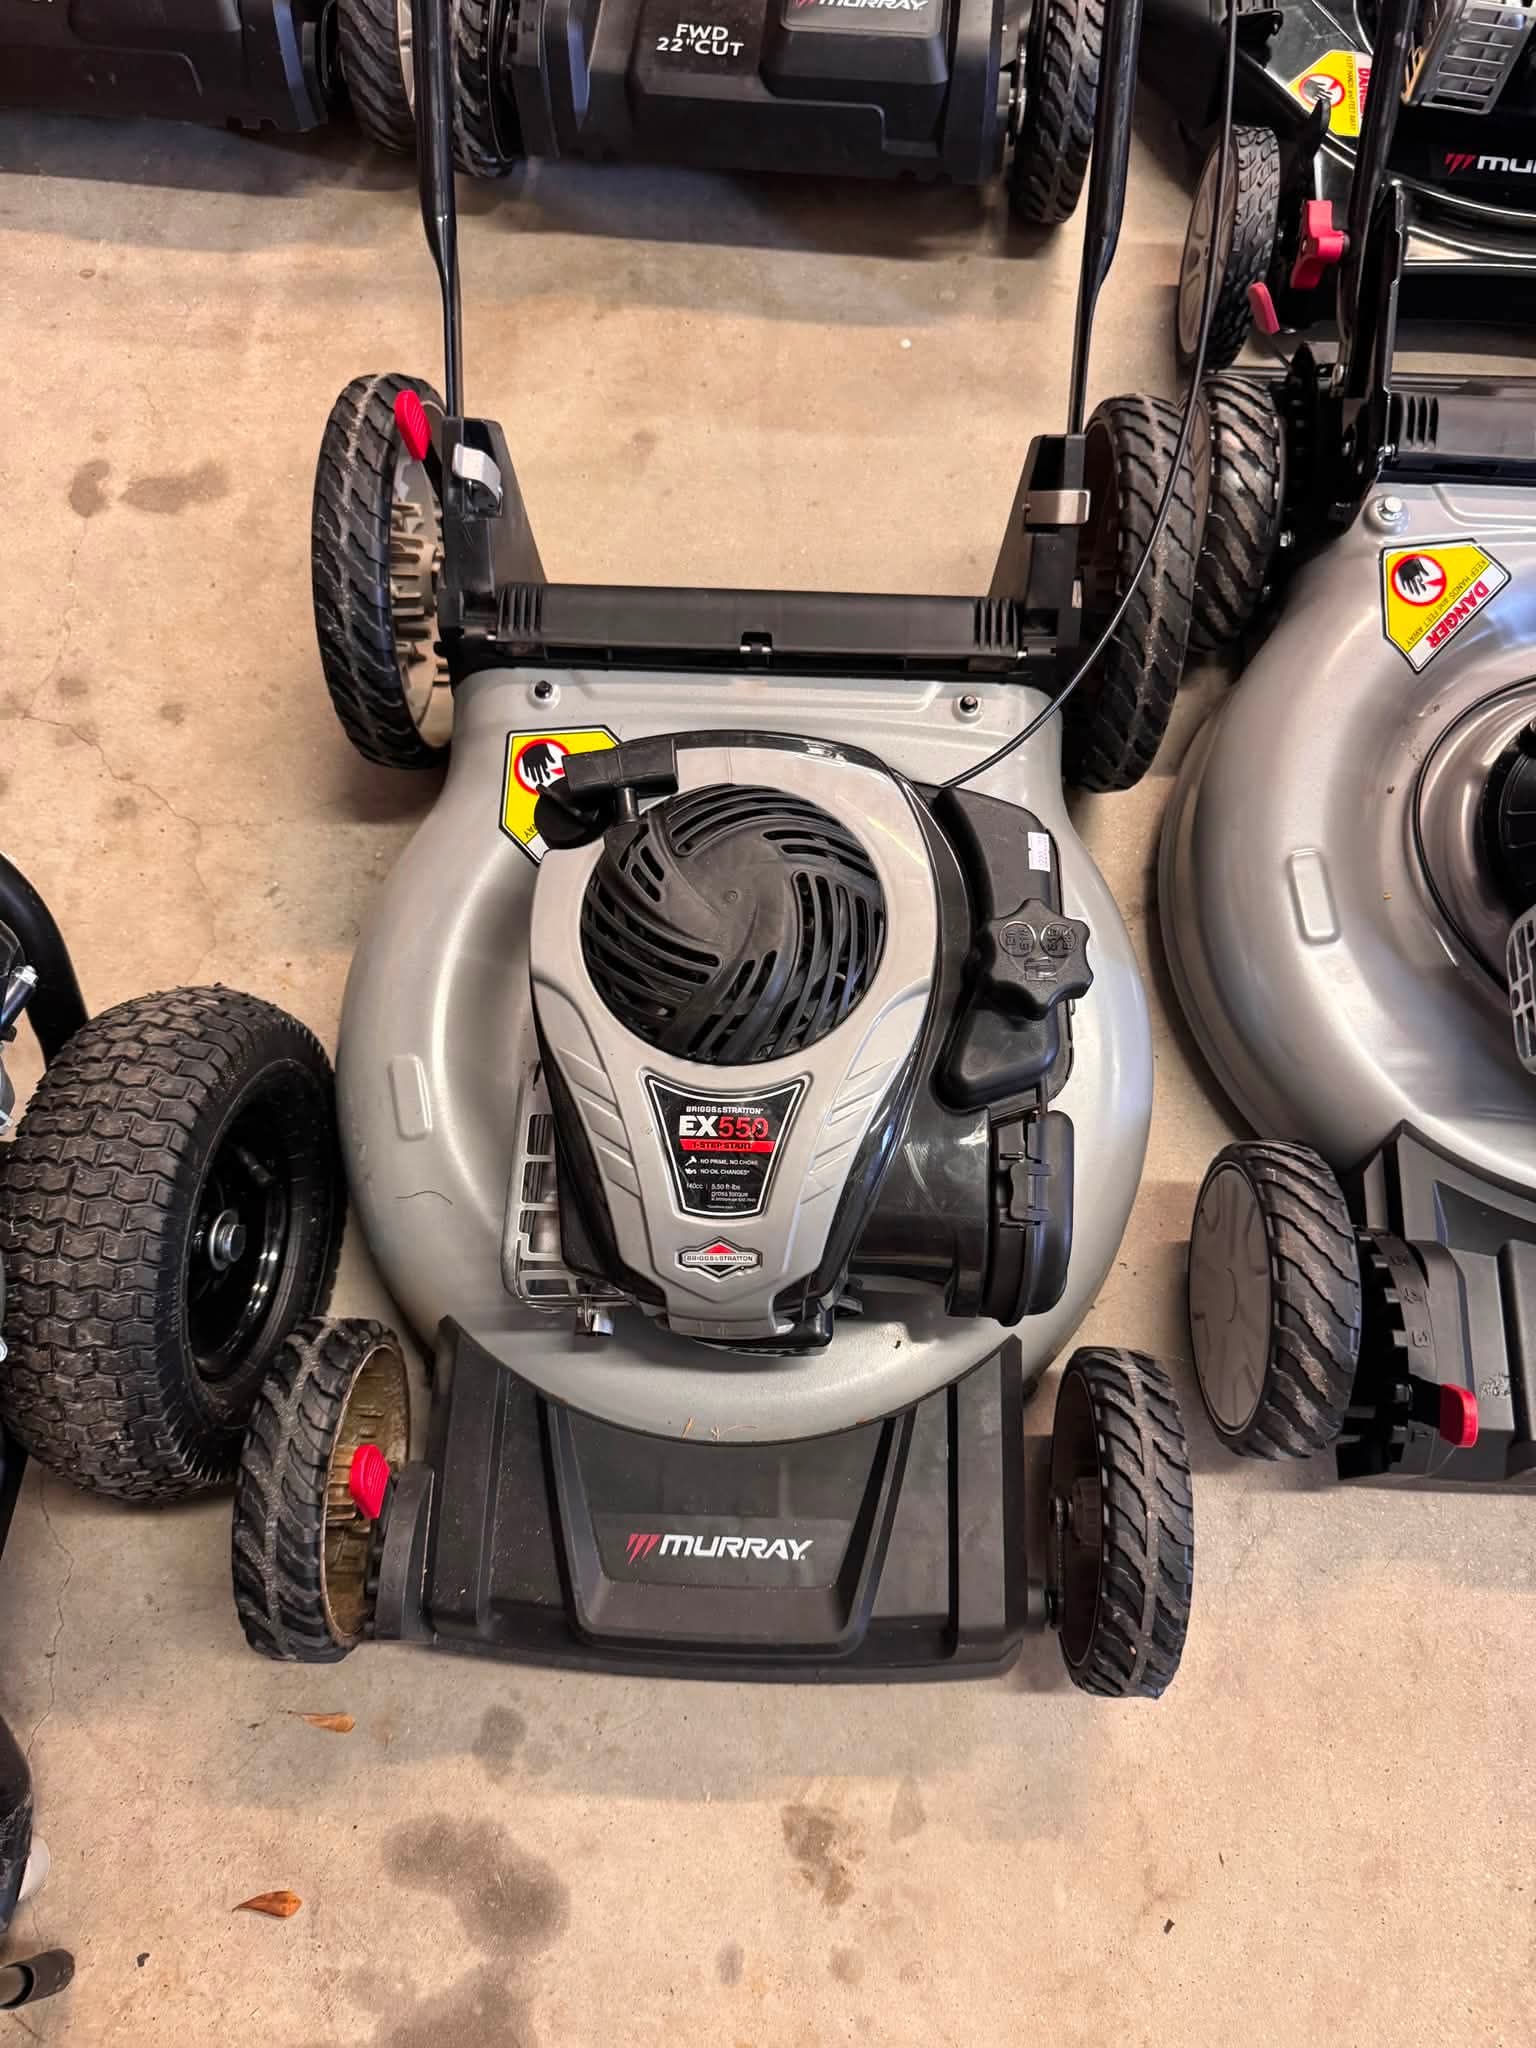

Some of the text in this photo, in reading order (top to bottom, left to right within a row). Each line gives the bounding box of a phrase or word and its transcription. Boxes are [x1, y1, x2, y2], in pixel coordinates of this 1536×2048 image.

[676, 23, 729, 40] FWD
[656, 36, 744, 56] 22"CUT
[1477, 155, 1536, 174] MU
[1470, 559, 1487, 578] KEEP
[1449, 575, 1472, 600] HANDS
[1424, 611, 1439, 628] FEET
[1425, 580, 1490, 648] DANGER
[1406, 626, 1424, 647] AWAY
[679, 1115, 769, 1138] EX550
[659, 1534, 814, 1561] MURRAY
